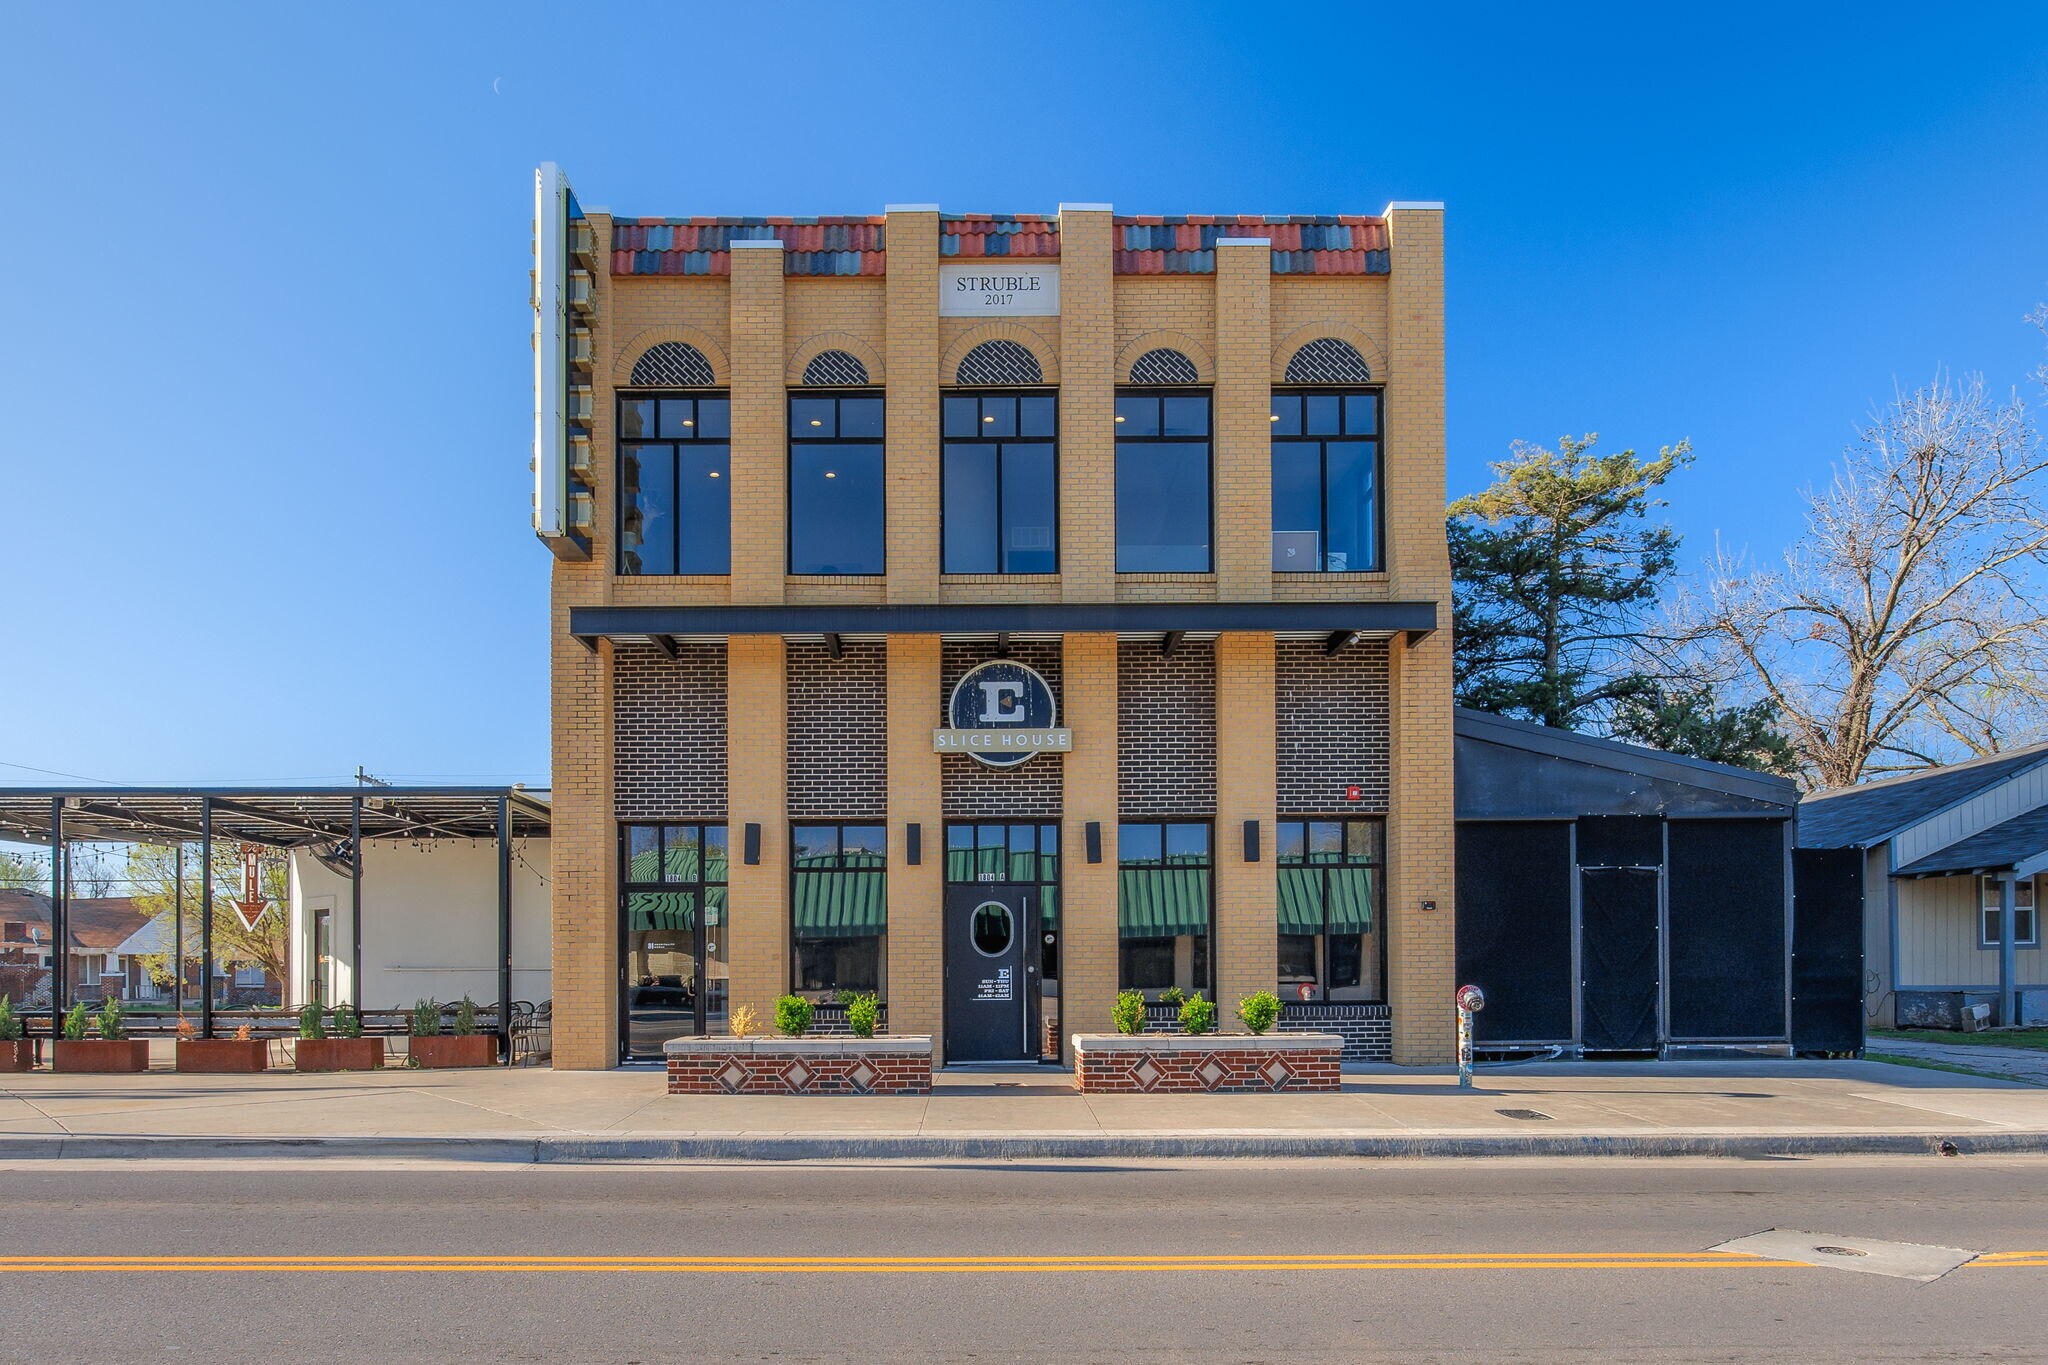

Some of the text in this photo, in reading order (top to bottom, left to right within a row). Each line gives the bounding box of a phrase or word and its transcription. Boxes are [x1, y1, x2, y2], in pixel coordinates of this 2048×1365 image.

[957, 276, 1041, 291] STRUBLE
[985, 294, 1013, 305] 2017
[978, 681, 1025, 722] E
[938, 734, 1067, 746] SLICE HOUSE
[248, 853, 256, 903] MULE
[998, 969, 1009, 978] E
